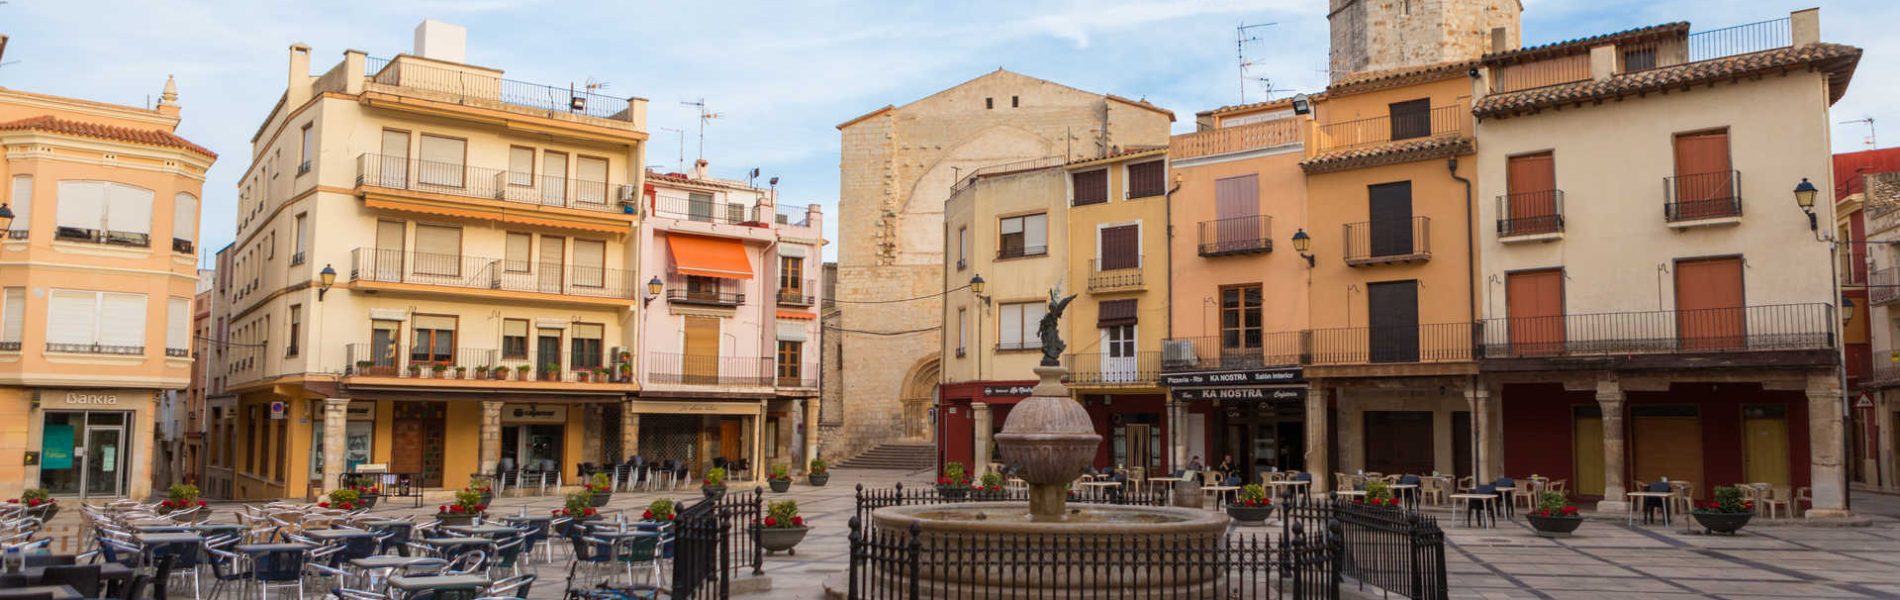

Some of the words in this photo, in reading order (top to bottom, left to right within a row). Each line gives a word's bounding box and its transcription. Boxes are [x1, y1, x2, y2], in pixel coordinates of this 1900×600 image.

[1210, 374, 1220, 382] KA
[1220, 373, 1248, 381] NOSTRA
[66, 392, 117, 405] Bankia
[1202, 389, 1217, 399] KA
[1220, 388, 1263, 399] NOSTRA
